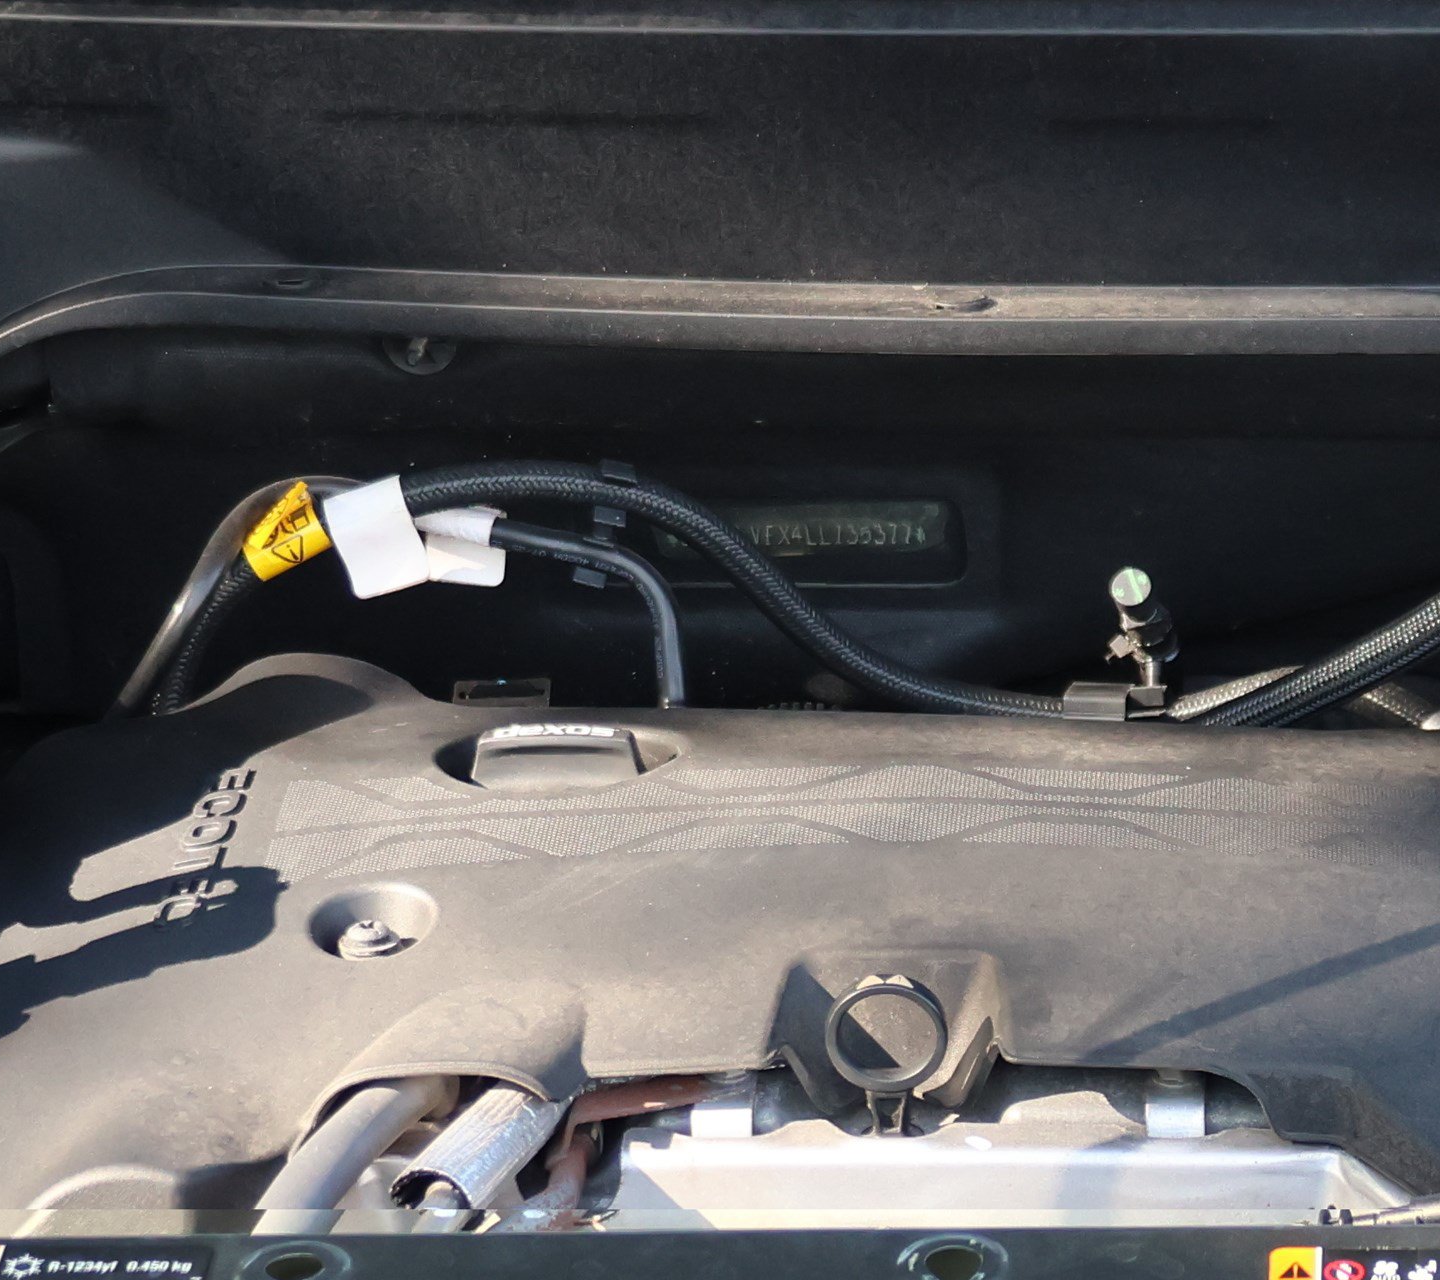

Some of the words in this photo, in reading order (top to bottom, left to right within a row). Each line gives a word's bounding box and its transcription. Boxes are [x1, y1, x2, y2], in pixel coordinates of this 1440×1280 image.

[47, 1260, 118, 1274] R-1234yf
[126, 1260, 169, 1273] 0.450
[171, 1260, 193, 1274] kg
